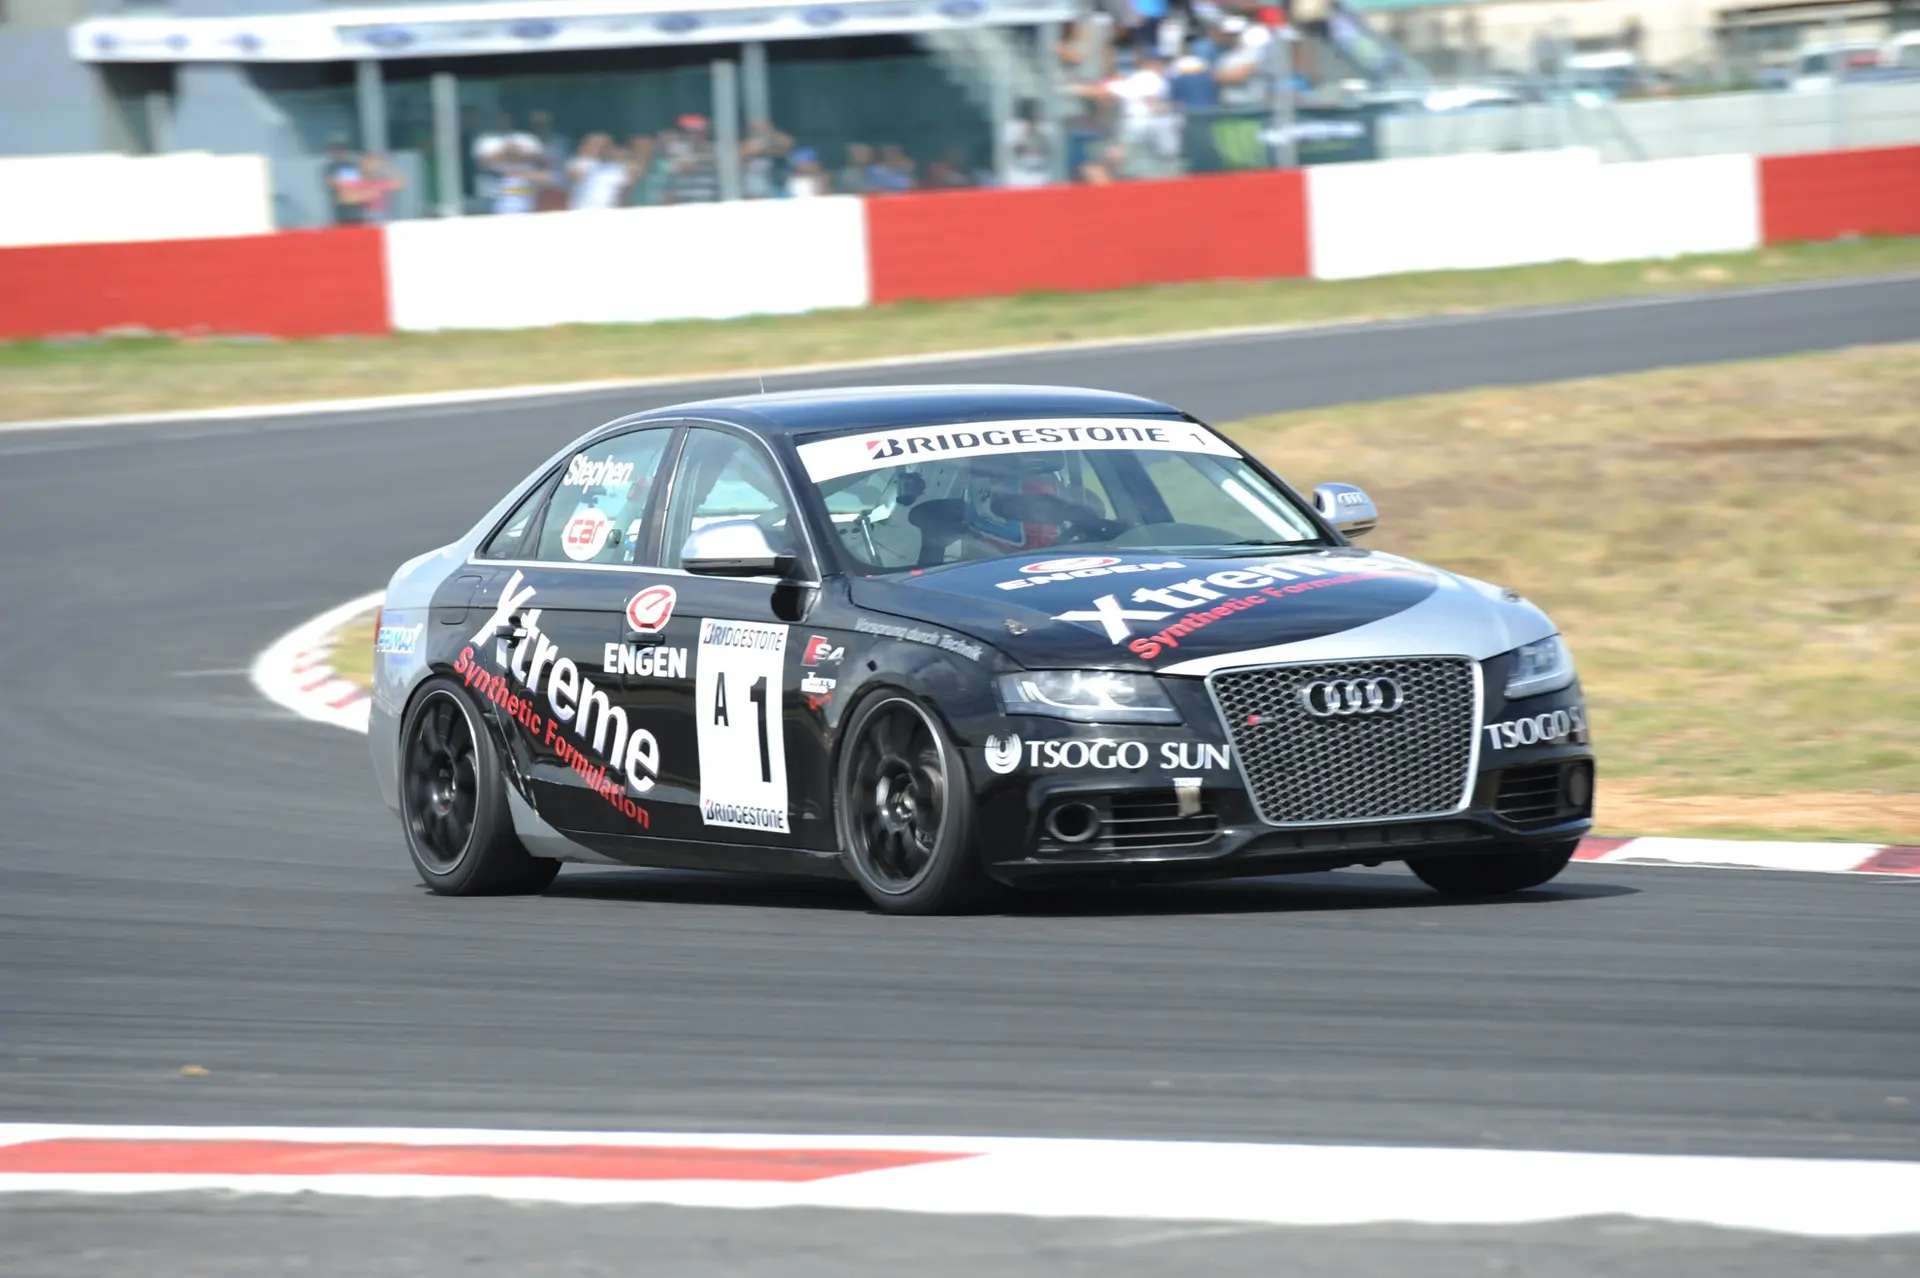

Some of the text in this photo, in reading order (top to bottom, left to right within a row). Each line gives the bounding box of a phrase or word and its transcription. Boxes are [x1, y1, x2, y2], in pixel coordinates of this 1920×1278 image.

[866, 426, 1170, 460] BRIDGESTONE
[563, 453, 635, 494] Stephen
[567, 519, 605, 545] car
[994, 560, 1187, 591] ENGEN
[703, 622, 785, 652] BRIDGESTONE
[1128, 594, 1269, 660] Synthetic
[603, 642, 688, 679] ENGEN
[812, 643, 845, 666] S4
[938, 633, 984, 661] Technik
[469, 568, 660, 793] Xtreme
[453, 645, 650, 830] Synthetic Formulation
[714, 671, 772, 783] A 1
[1483, 709, 1571, 750] TSOGO
[1024, 740, 1231, 771] TSOGO SUN
[705, 798, 785, 830] BRIDGESTONE
